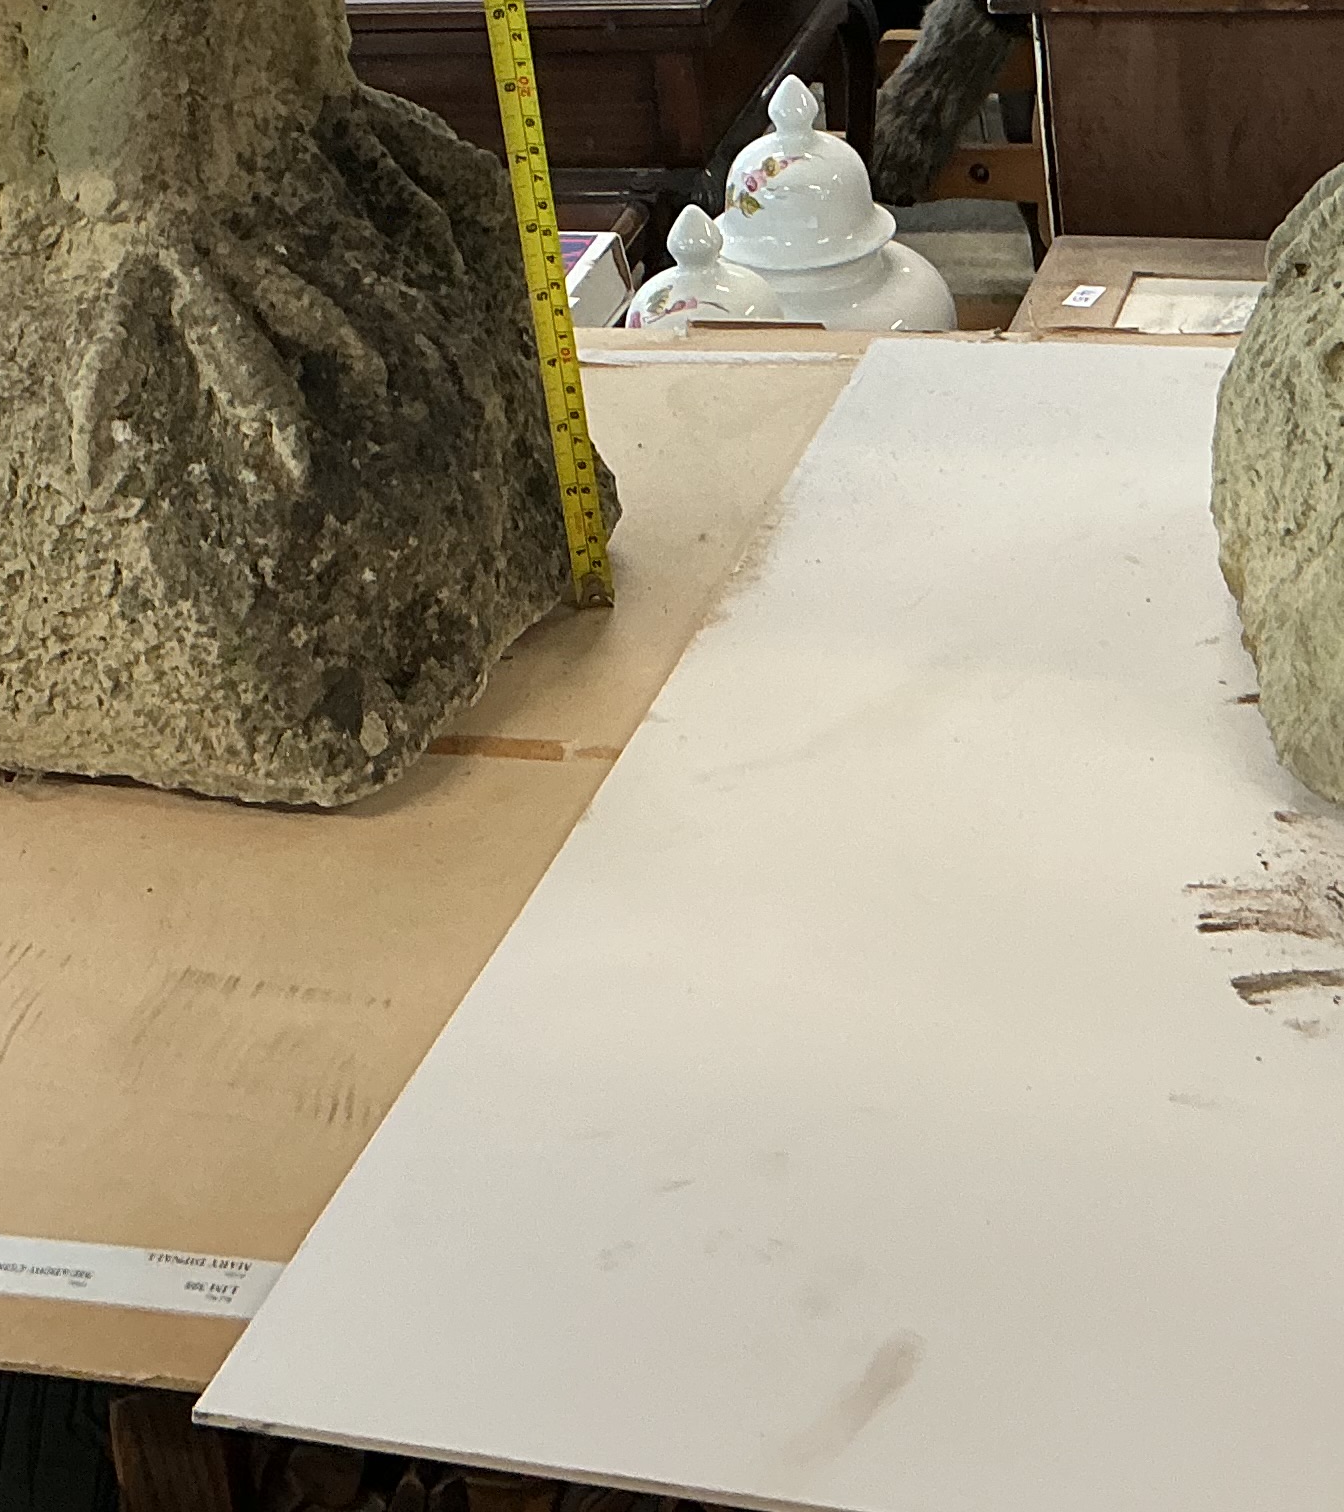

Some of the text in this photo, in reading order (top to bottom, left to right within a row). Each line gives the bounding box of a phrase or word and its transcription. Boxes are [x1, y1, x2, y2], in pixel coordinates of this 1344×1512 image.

[508, 4, 518, 12] 3
[493, 9, 505, 19] 9
[512, 33, 522, 41] 2
[518, 77, 531, 97] 20
[515, 155, 527, 164] 7
[526, 223, 537, 233] 6
[537, 292, 548, 301] 5
[555, 308, 564, 316] 2
[547, 359, 557, 367] 4
[557, 424, 567, 432] 3
[566, 486, 577, 496] 2
[592, 560, 602, 568] 2
